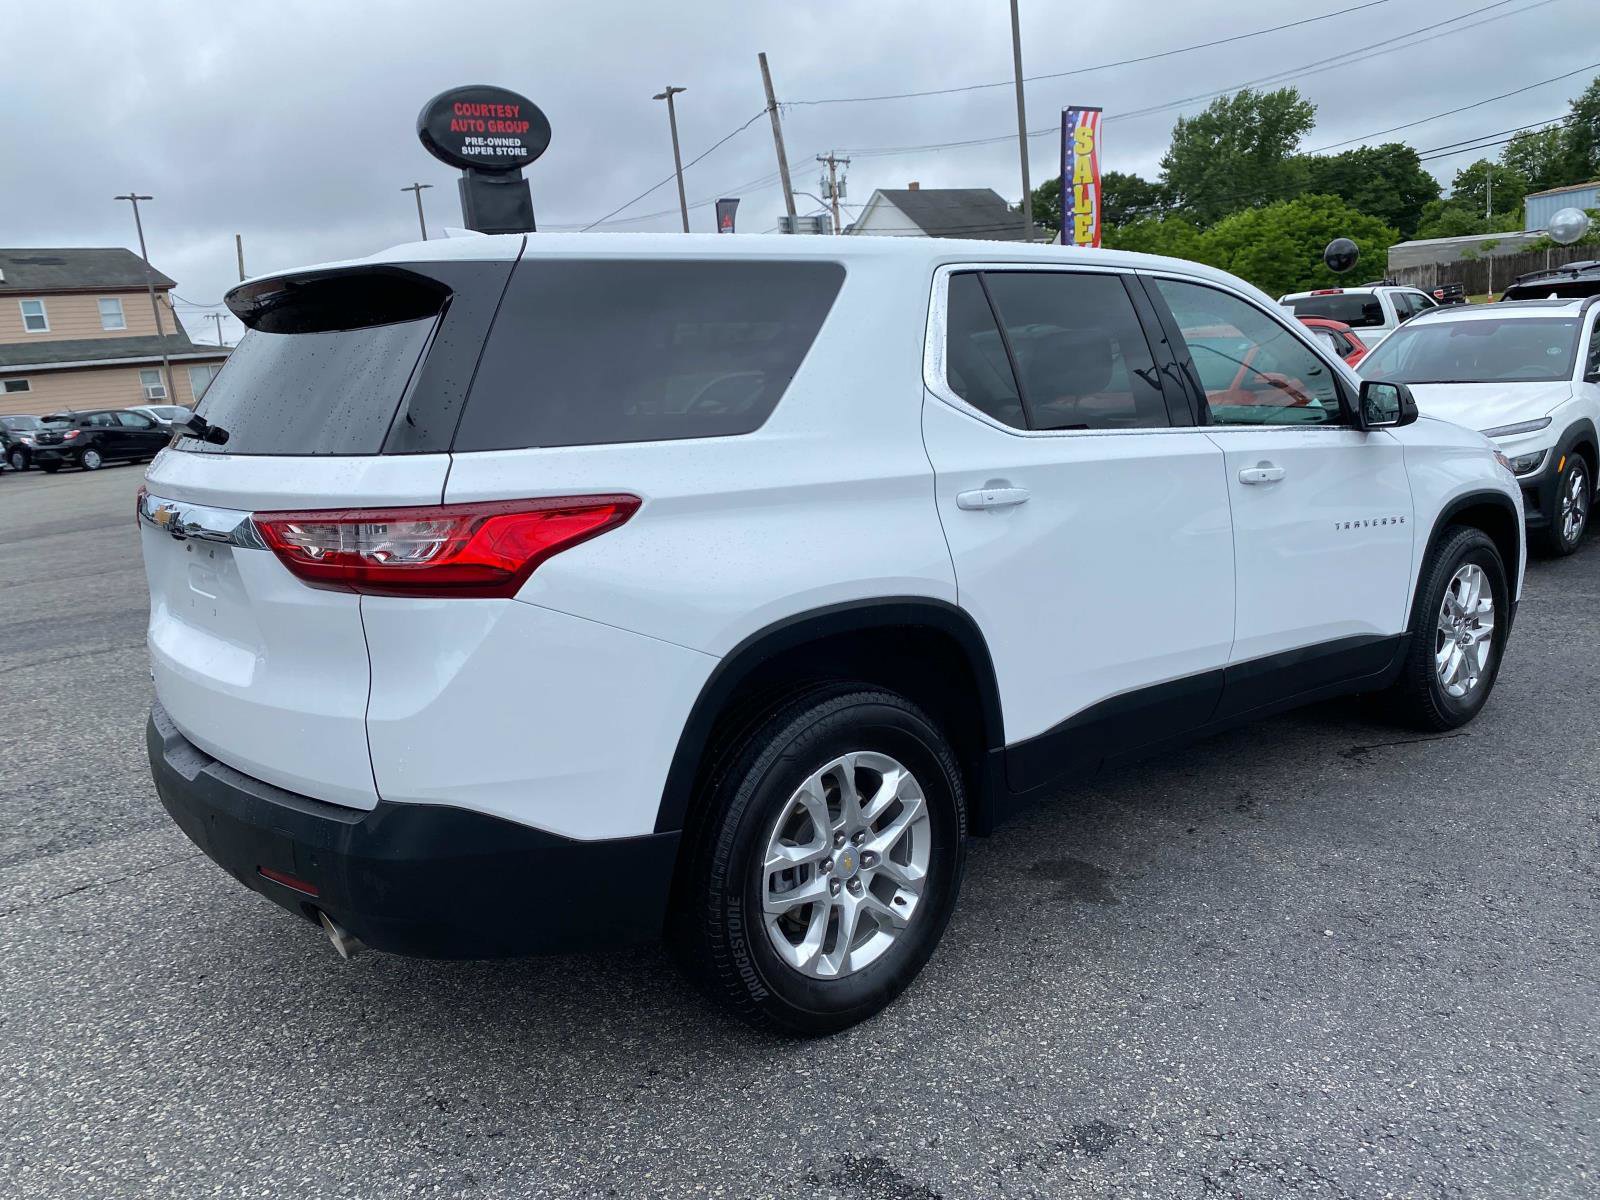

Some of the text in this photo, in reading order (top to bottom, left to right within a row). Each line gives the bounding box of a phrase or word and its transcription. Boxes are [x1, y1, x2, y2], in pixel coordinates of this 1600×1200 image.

[453, 102, 519, 118] COURTESY
[450, 119, 529, 134] AUTO GROUP
[464, 136, 521, 147] PRE-OWNED
[461, 146, 528, 156] SUPER STORE
[1073, 126, 1094, 243] SALE
[1334, 515, 1405, 530] TRAVERSE
[728, 895, 769, 1002] BRIDGESTONE
